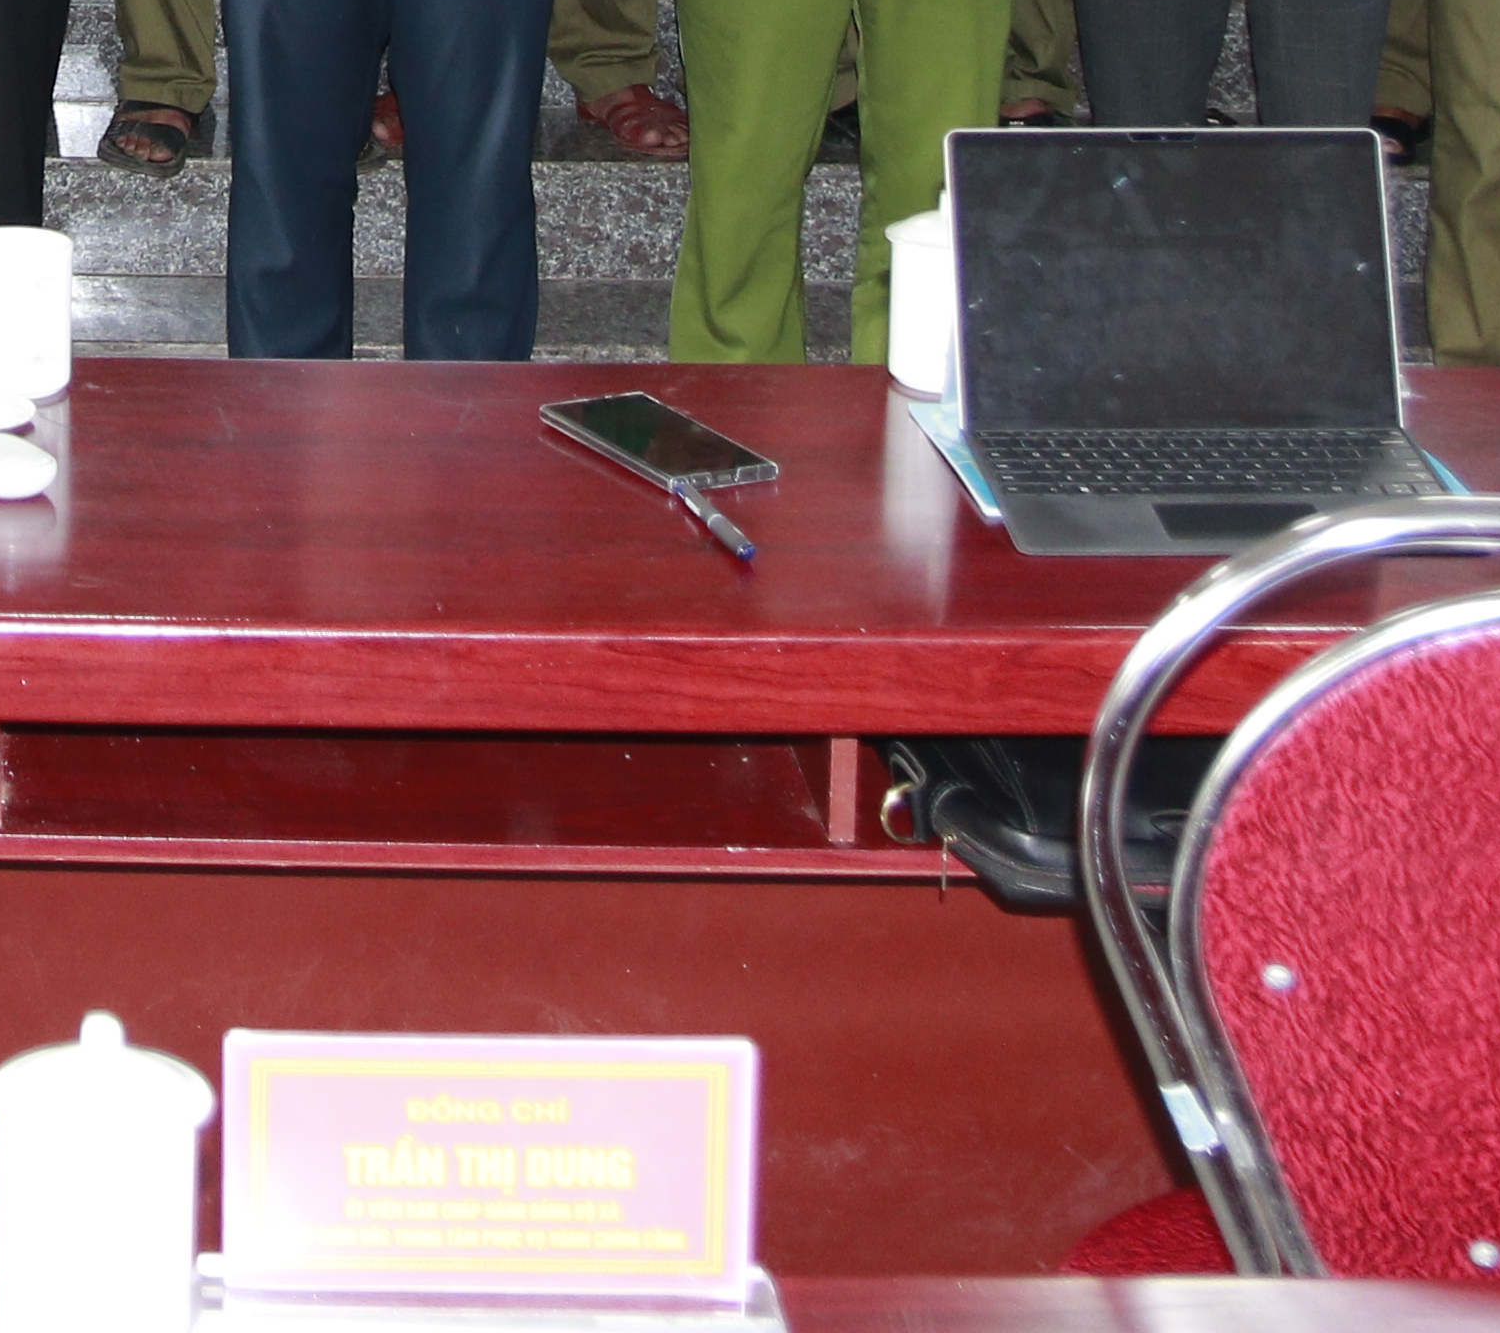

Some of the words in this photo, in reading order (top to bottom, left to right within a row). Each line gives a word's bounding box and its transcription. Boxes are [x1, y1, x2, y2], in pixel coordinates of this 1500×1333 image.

[406, 1093, 501, 1122] ĐỒNG
[512, 1097, 569, 1122] CHÍ
[345, 1134, 446, 1187] TRẦN
[456, 1146, 516, 1195] THỊ
[527, 1146, 634, 1188] DUNG
